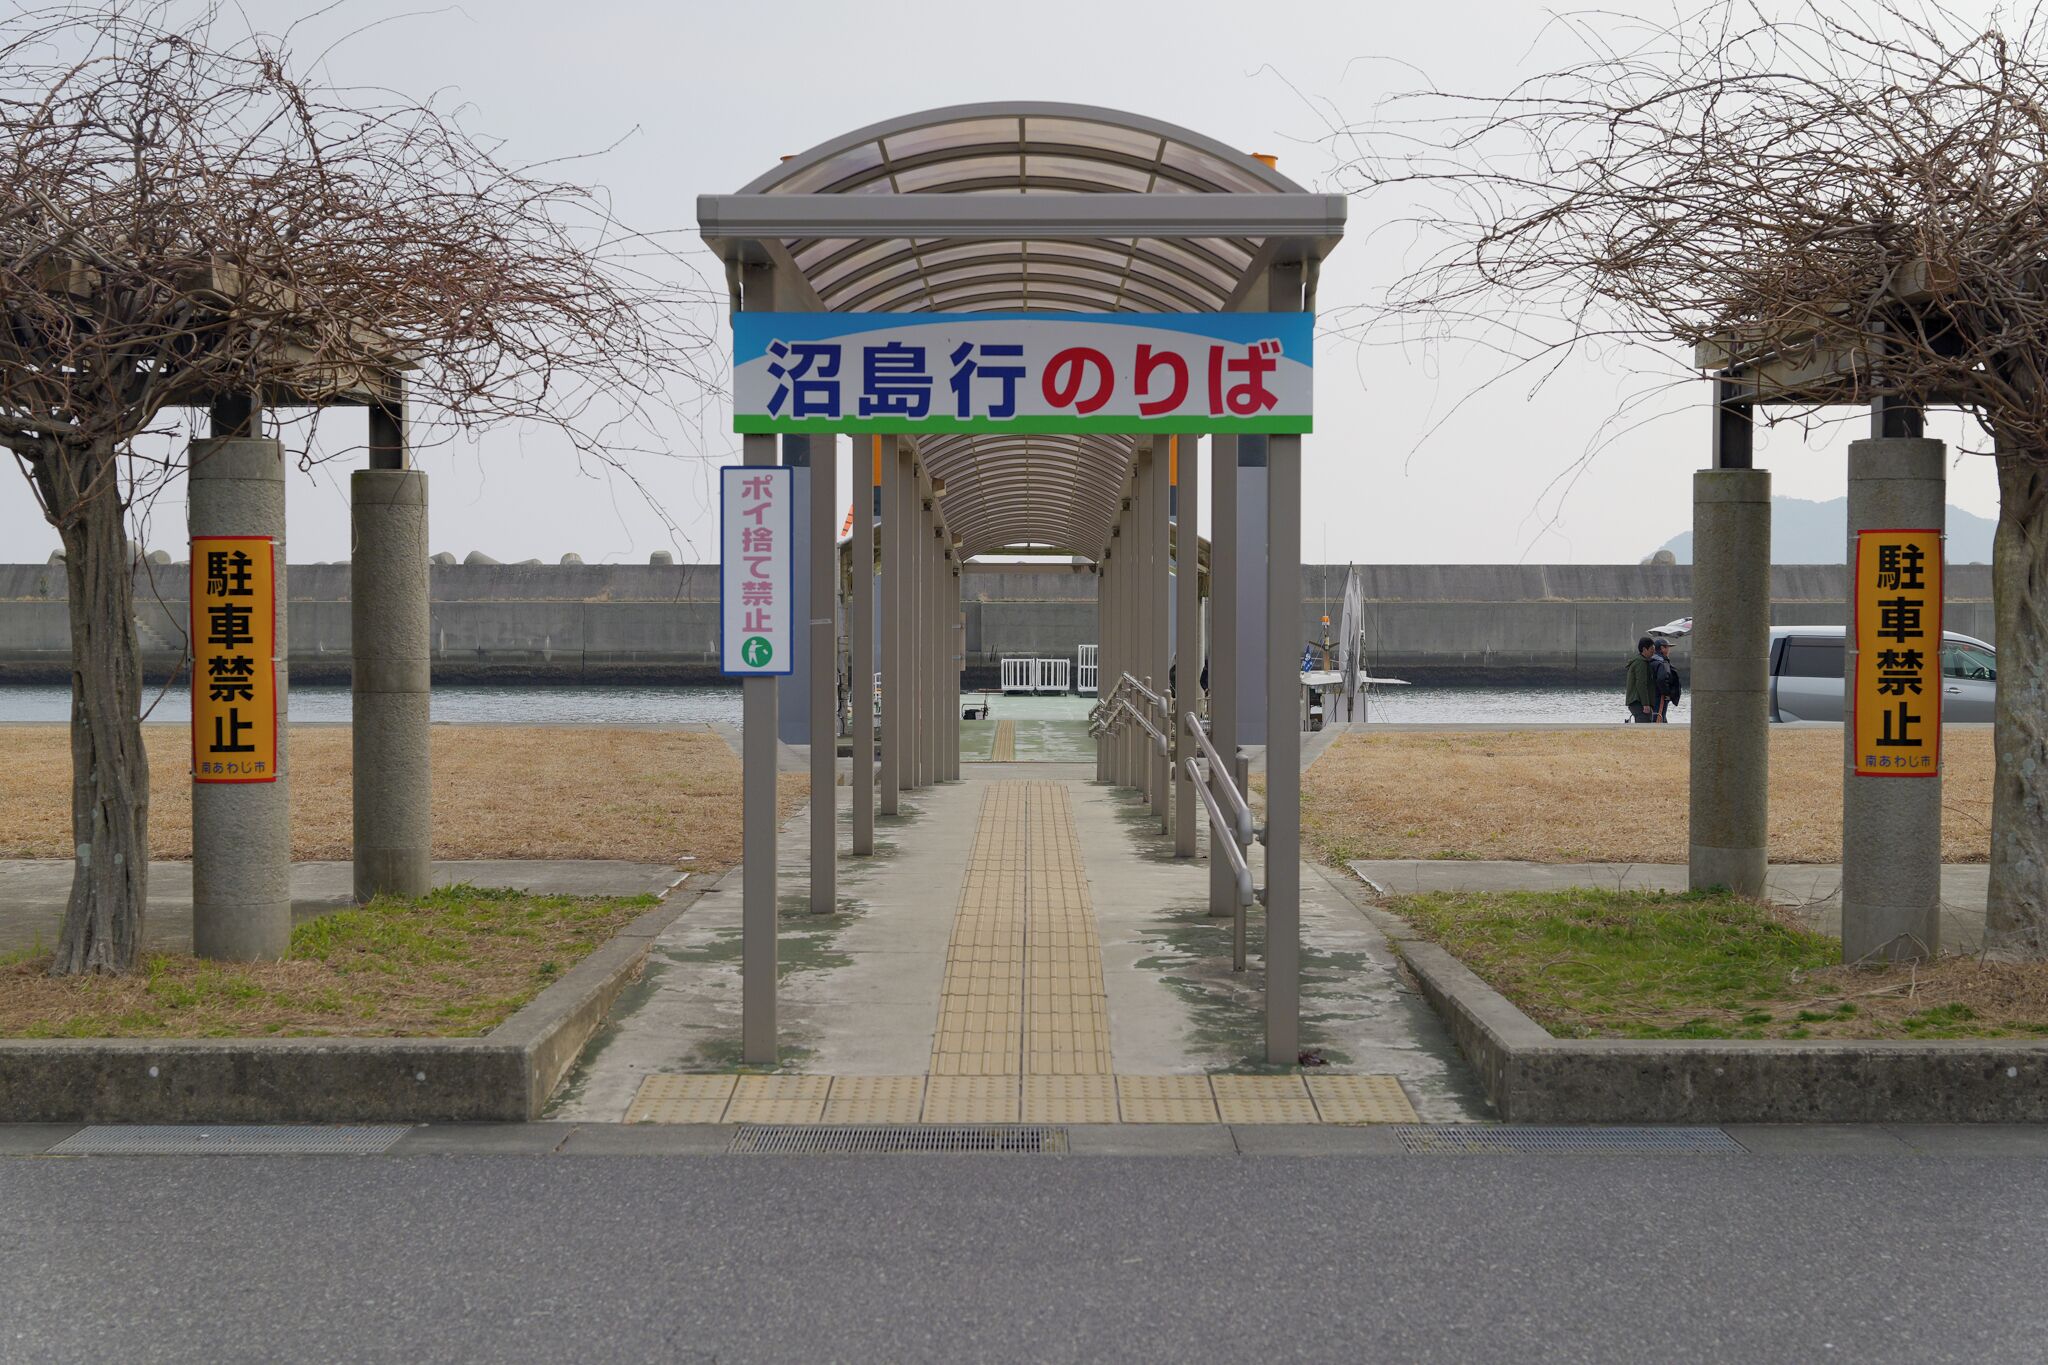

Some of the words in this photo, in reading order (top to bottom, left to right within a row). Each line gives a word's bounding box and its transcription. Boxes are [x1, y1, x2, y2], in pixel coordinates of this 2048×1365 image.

[767, 341, 1281, 418] 沼島行のりば
[742, 474, 773, 632] ポイ捨て禁止
[207, 550, 255, 753] 駐車禁止
[1876, 543, 1925, 747] 駐車禁止
[201, 761, 265, 775] 南あわじ市
[1865, 754, 1931, 768] 南あわじ市
